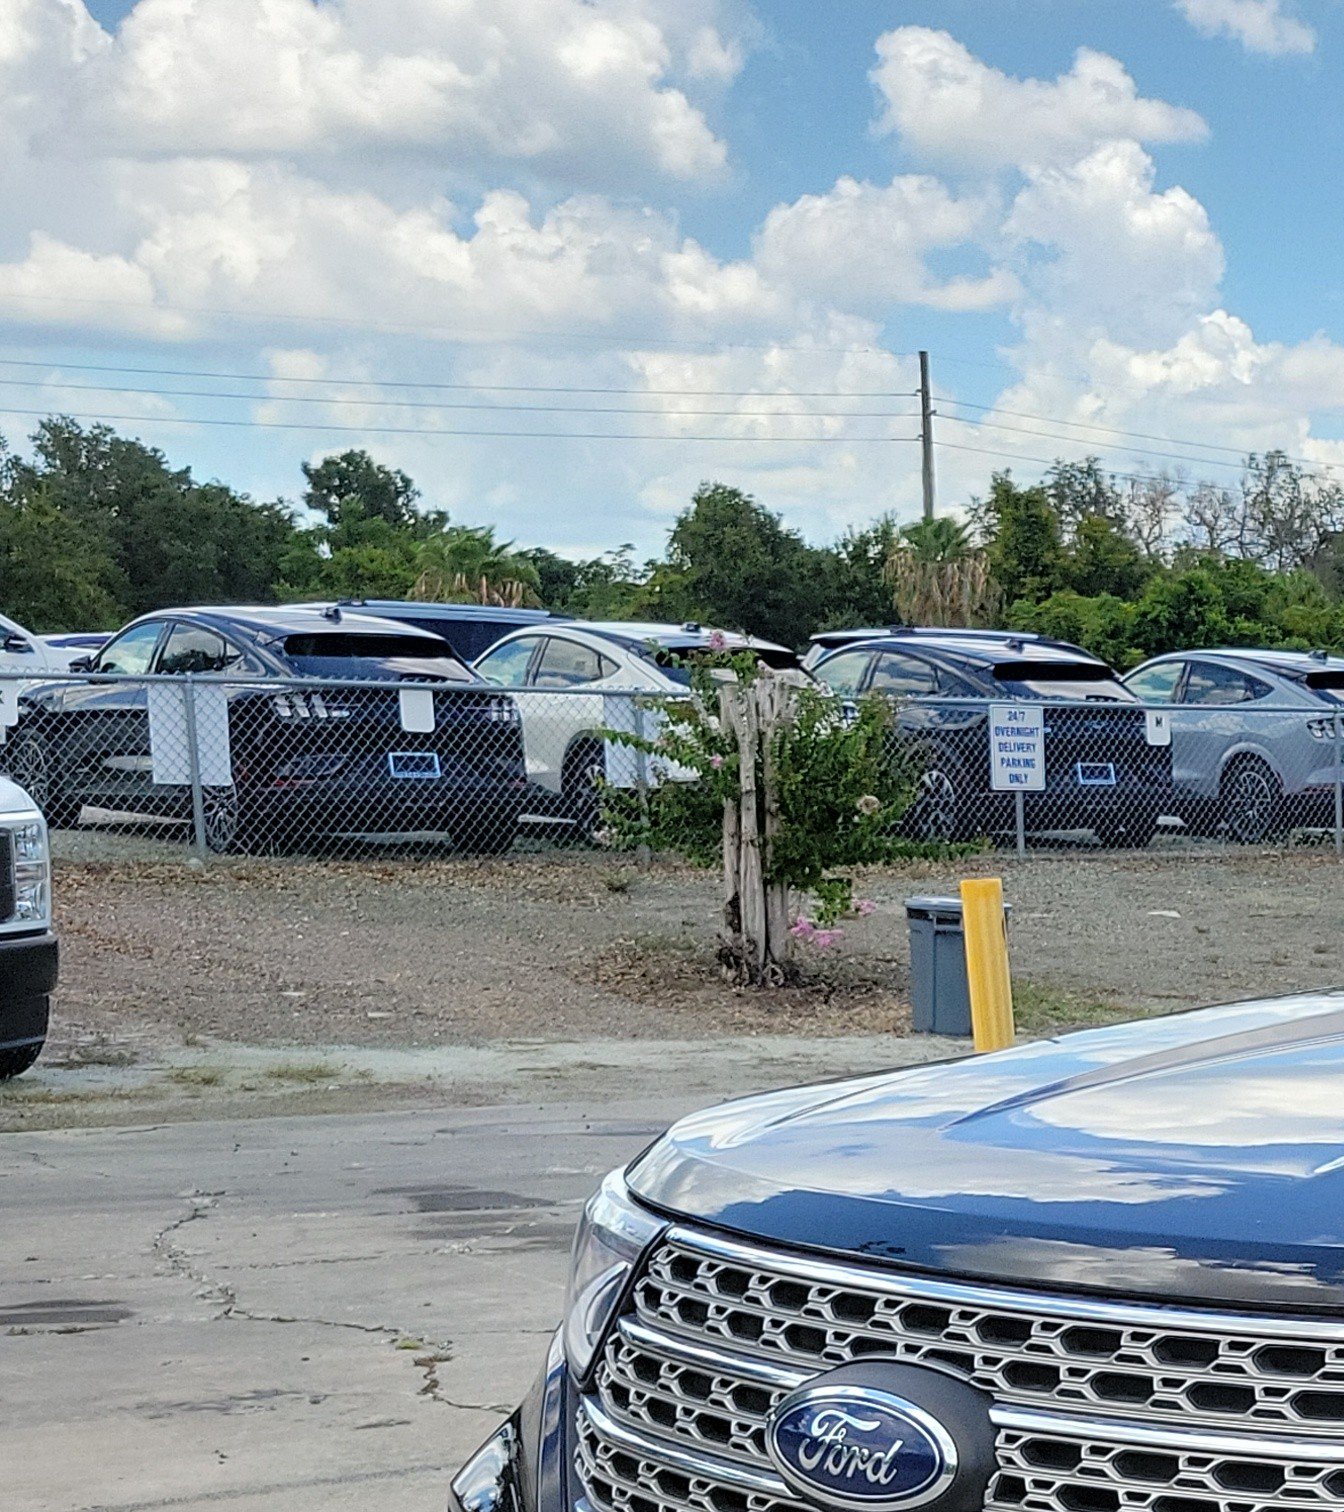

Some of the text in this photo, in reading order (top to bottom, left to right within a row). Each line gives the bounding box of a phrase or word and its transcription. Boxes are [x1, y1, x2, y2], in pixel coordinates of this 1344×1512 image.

[995, 726, 1039, 737] OVERNIGHT
[998, 742, 1036, 753] DELIVERY
[1001, 757, 1036, 768] PARKING
[1009, 774, 1028, 784] ONLY
[798, 1408, 904, 1485] Ford
